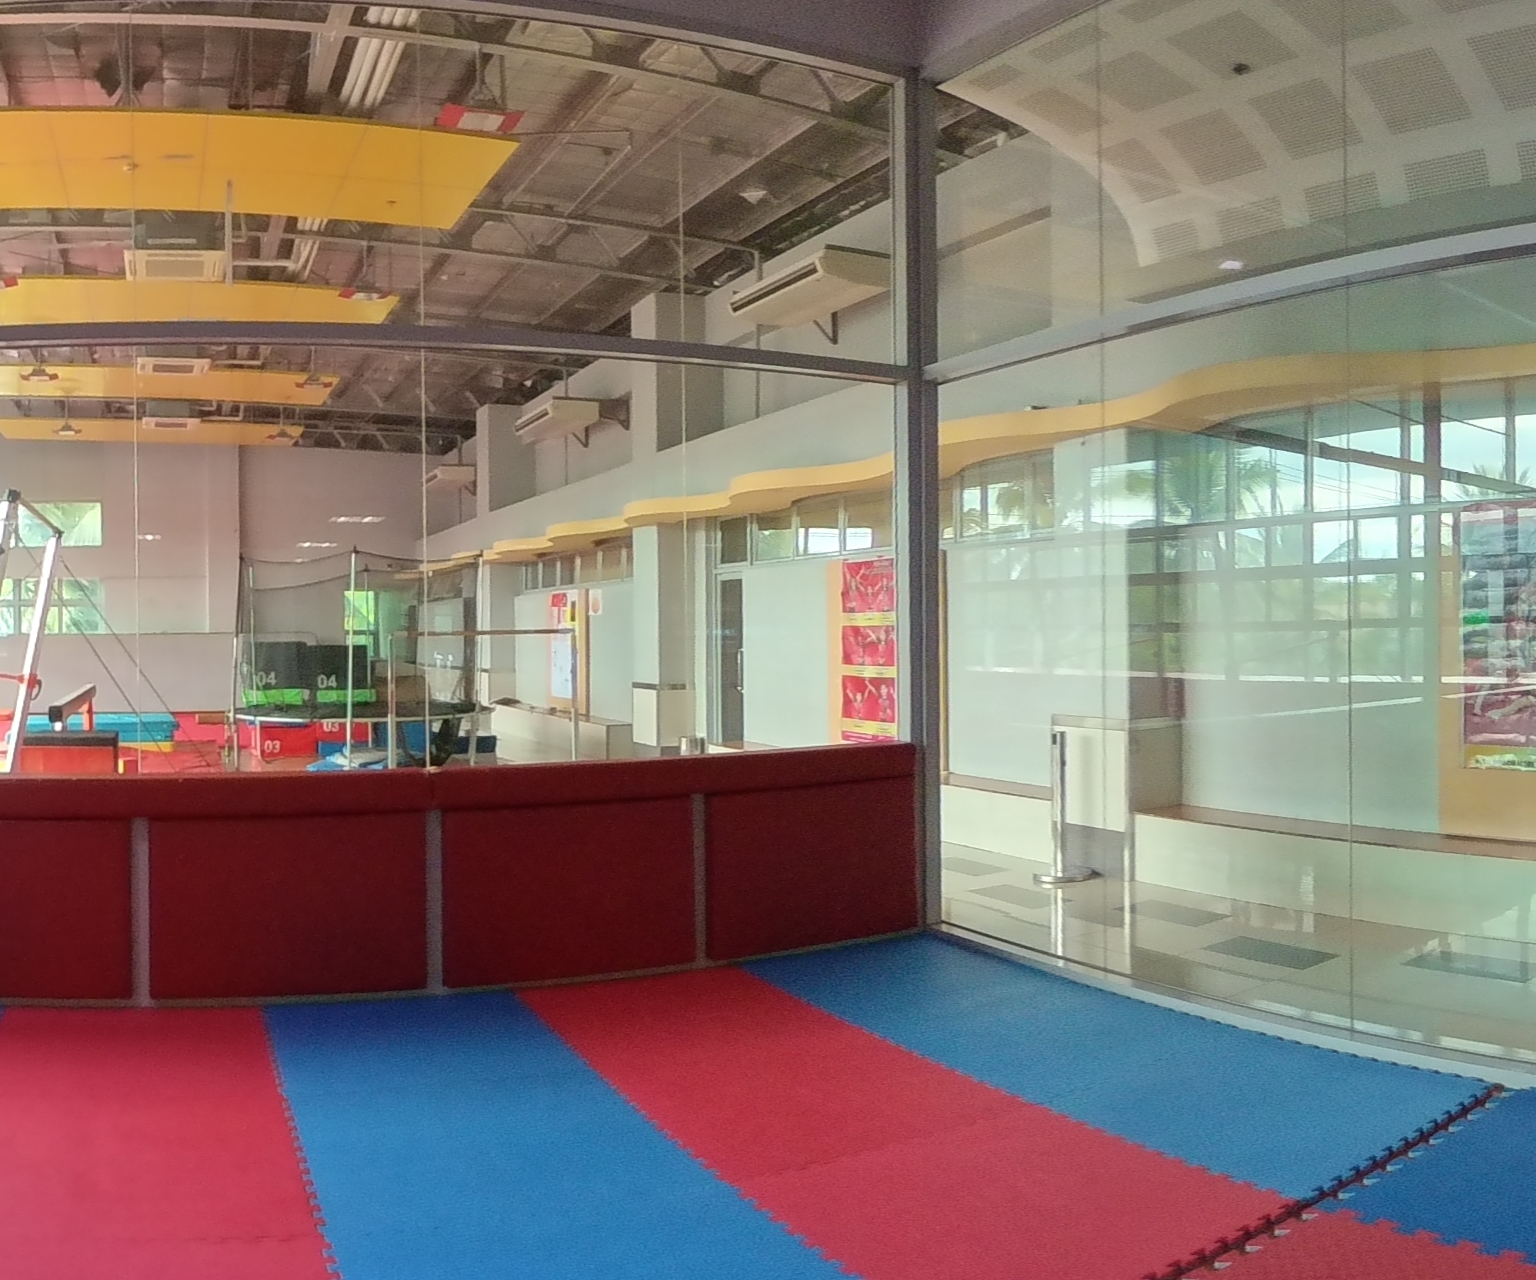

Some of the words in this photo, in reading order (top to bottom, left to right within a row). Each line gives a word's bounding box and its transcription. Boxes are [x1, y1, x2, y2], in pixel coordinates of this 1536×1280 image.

[257, 671, 277, 686] 04
[317, 674, 338, 689] 04
[264, 740, 281, 753] 03
